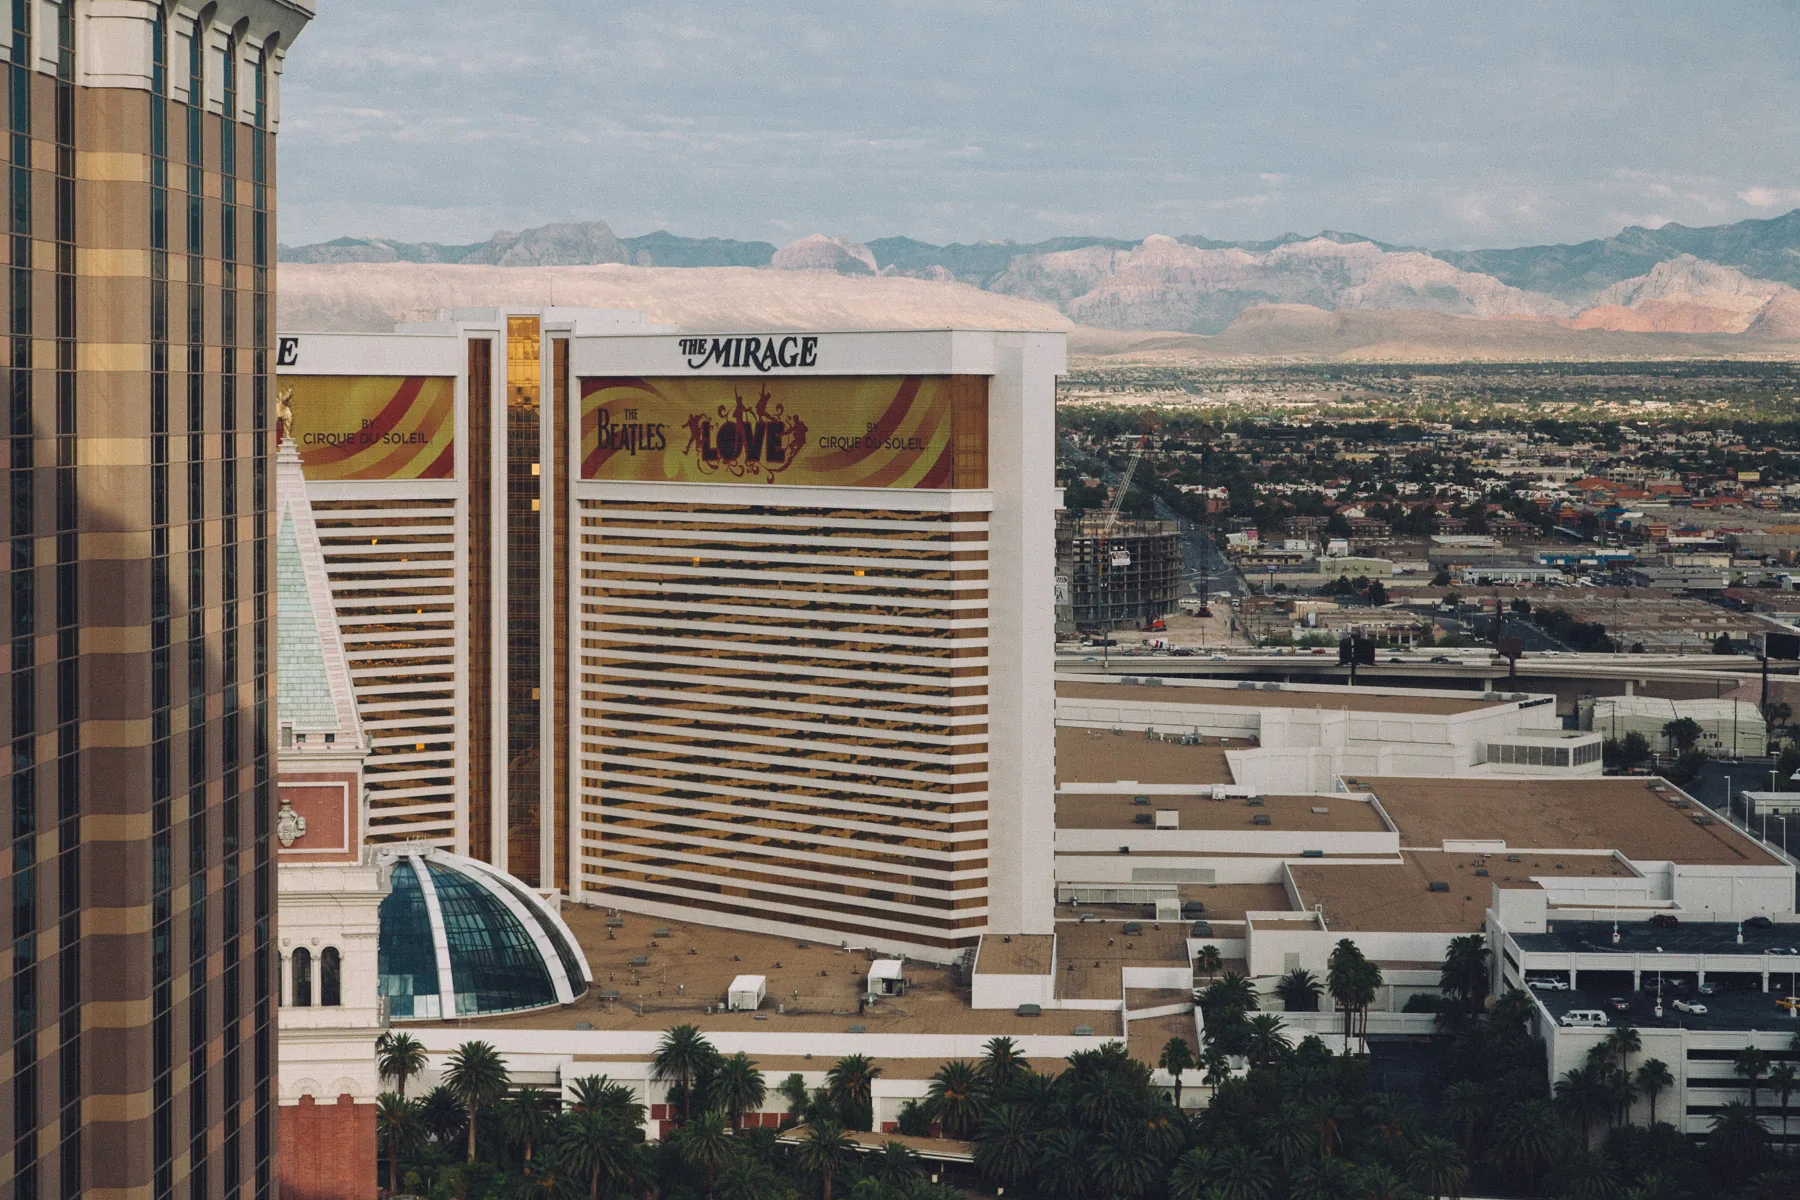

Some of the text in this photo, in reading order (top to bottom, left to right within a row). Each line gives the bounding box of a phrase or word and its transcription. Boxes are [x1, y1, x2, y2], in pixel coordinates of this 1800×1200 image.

[679, 336, 818, 372] THE MIRAGE
[624, 408, 639, 421] THE
[361, 419, 377, 429] BY
[598, 408, 666, 456] BEATLES
[867, 422, 879, 433] BY
[303, 432, 429, 448] CIRQUE DU SOLEIL
[702, 420, 786, 463] LOVE
[819, 436, 925, 452] CIRQUE DU SOLEIL
